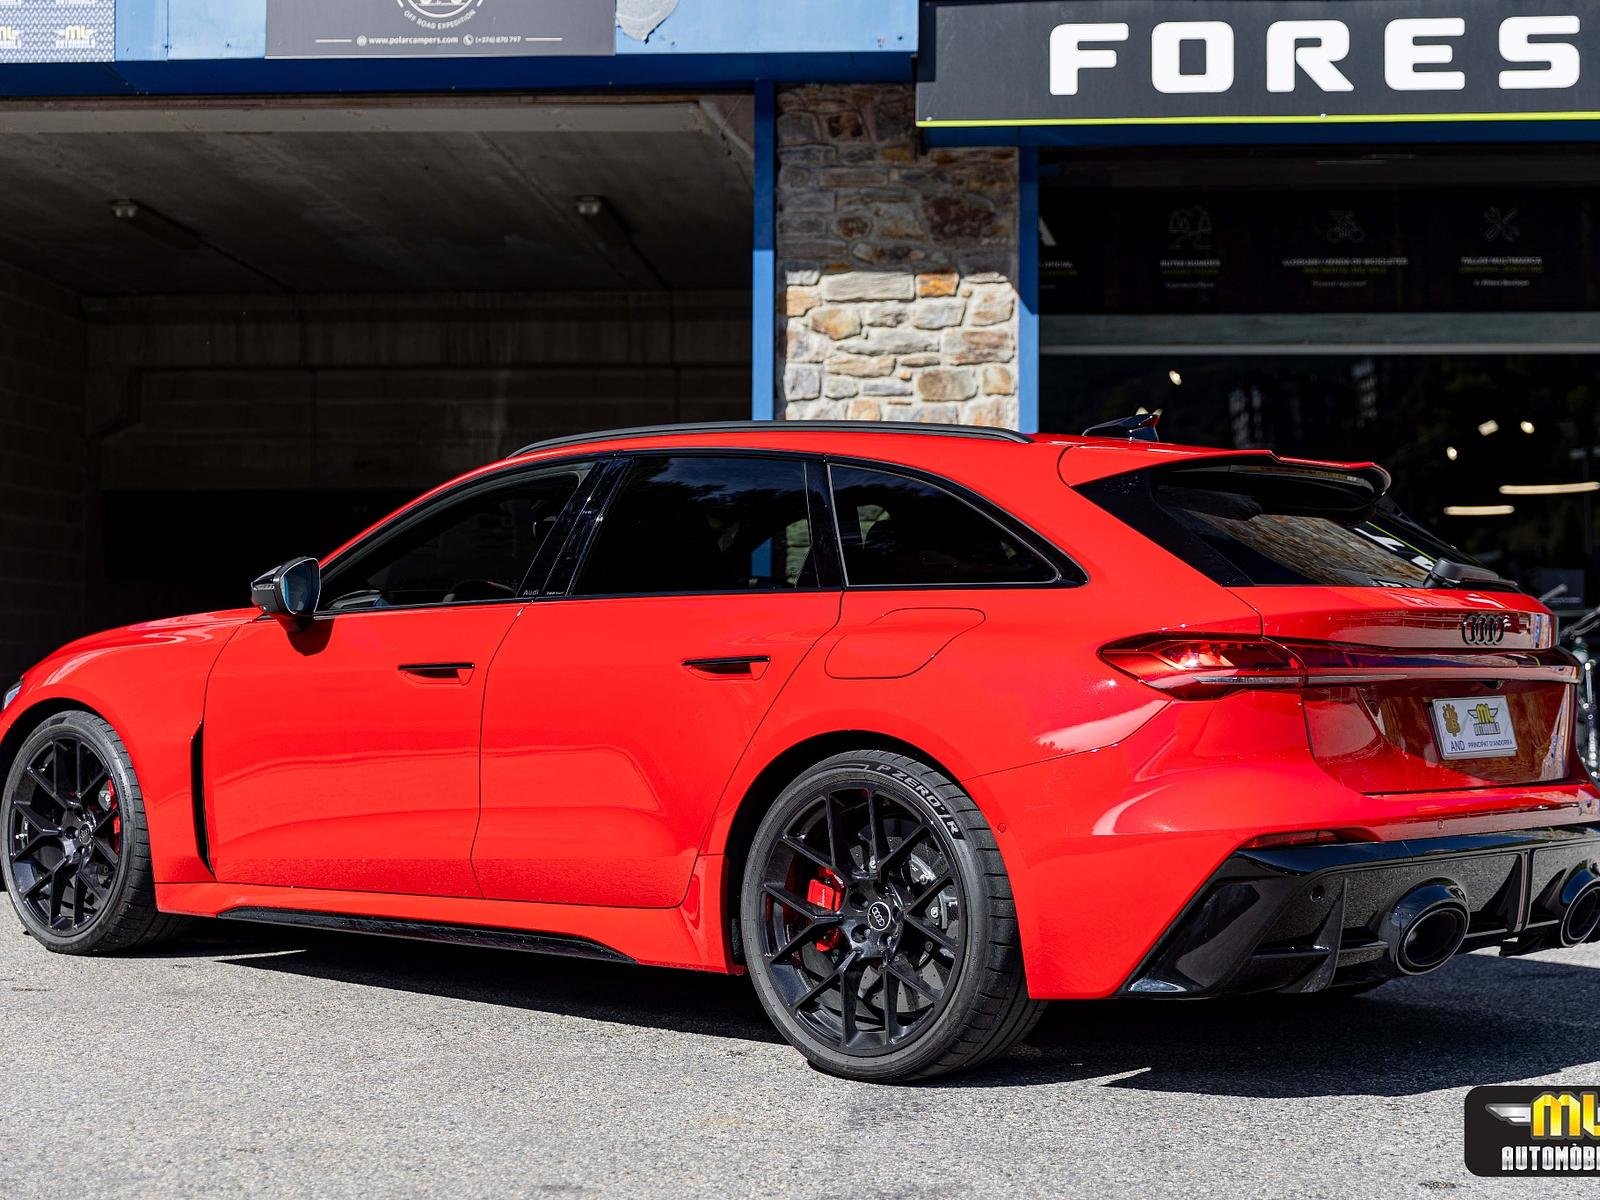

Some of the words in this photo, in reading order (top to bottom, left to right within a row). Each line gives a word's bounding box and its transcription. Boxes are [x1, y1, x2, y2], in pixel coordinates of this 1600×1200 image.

[404, 10, 417, 22] OFF
[416, 18, 436, 29] ROAD
[437, 9, 476, 30] EXPEDITION
[368, 36, 459, 45] www.polarcampers.com
[1049, 15, 1581, 95] FORES
[1450, 740, 1466, 751] AND
